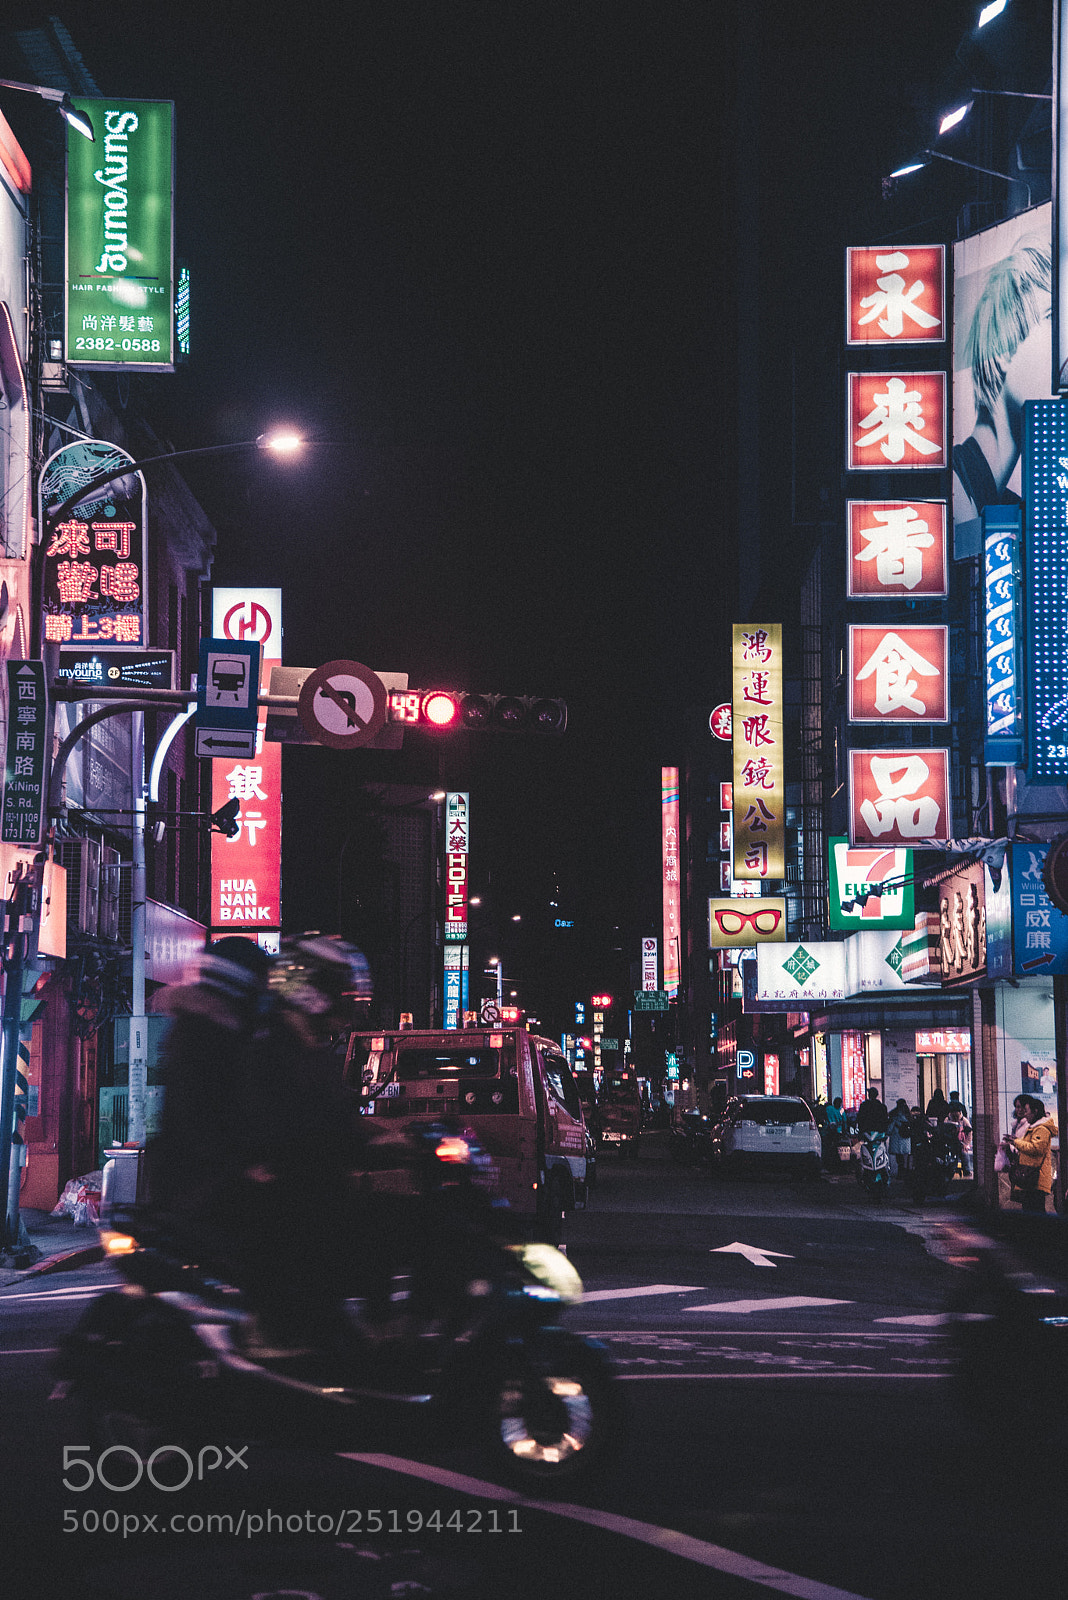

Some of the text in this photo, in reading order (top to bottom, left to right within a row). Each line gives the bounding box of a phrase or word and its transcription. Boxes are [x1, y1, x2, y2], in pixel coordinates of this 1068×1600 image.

[93, 110, 138, 273] Sunyoung
[137, 286, 165, 294] STYLE
[82, 315, 154, 332] 尚洋髮藝
[75, 337, 160, 352] 2382-0588
[57, 560, 140, 602] 歡唱
[392, 695, 420, 722] 49
[14, 681, 37, 776] 西寧南路
[740, 629, 776, 877] 鴻運眼鏡公司
[1047, 744, 1068, 759] 23
[7, 781, 40, 795] XiNing
[6, 797, 34, 808] S. Rd.
[25, 812, 39, 822] 108
[5, 828, 18, 838] 173
[25, 828, 36, 839] 78
[448, 818, 467, 852] 大榮
[219, 879, 257, 892] HUA
[447, 853, 466, 921] HOTEL
[219, 893, 257, 907] NAN
[219, 907, 271, 921] BANK
[1024, 909, 1051, 949] 威廉
[447, 972, 460, 1029] 天龍牌雨
[737, 1050, 755, 1079] P
